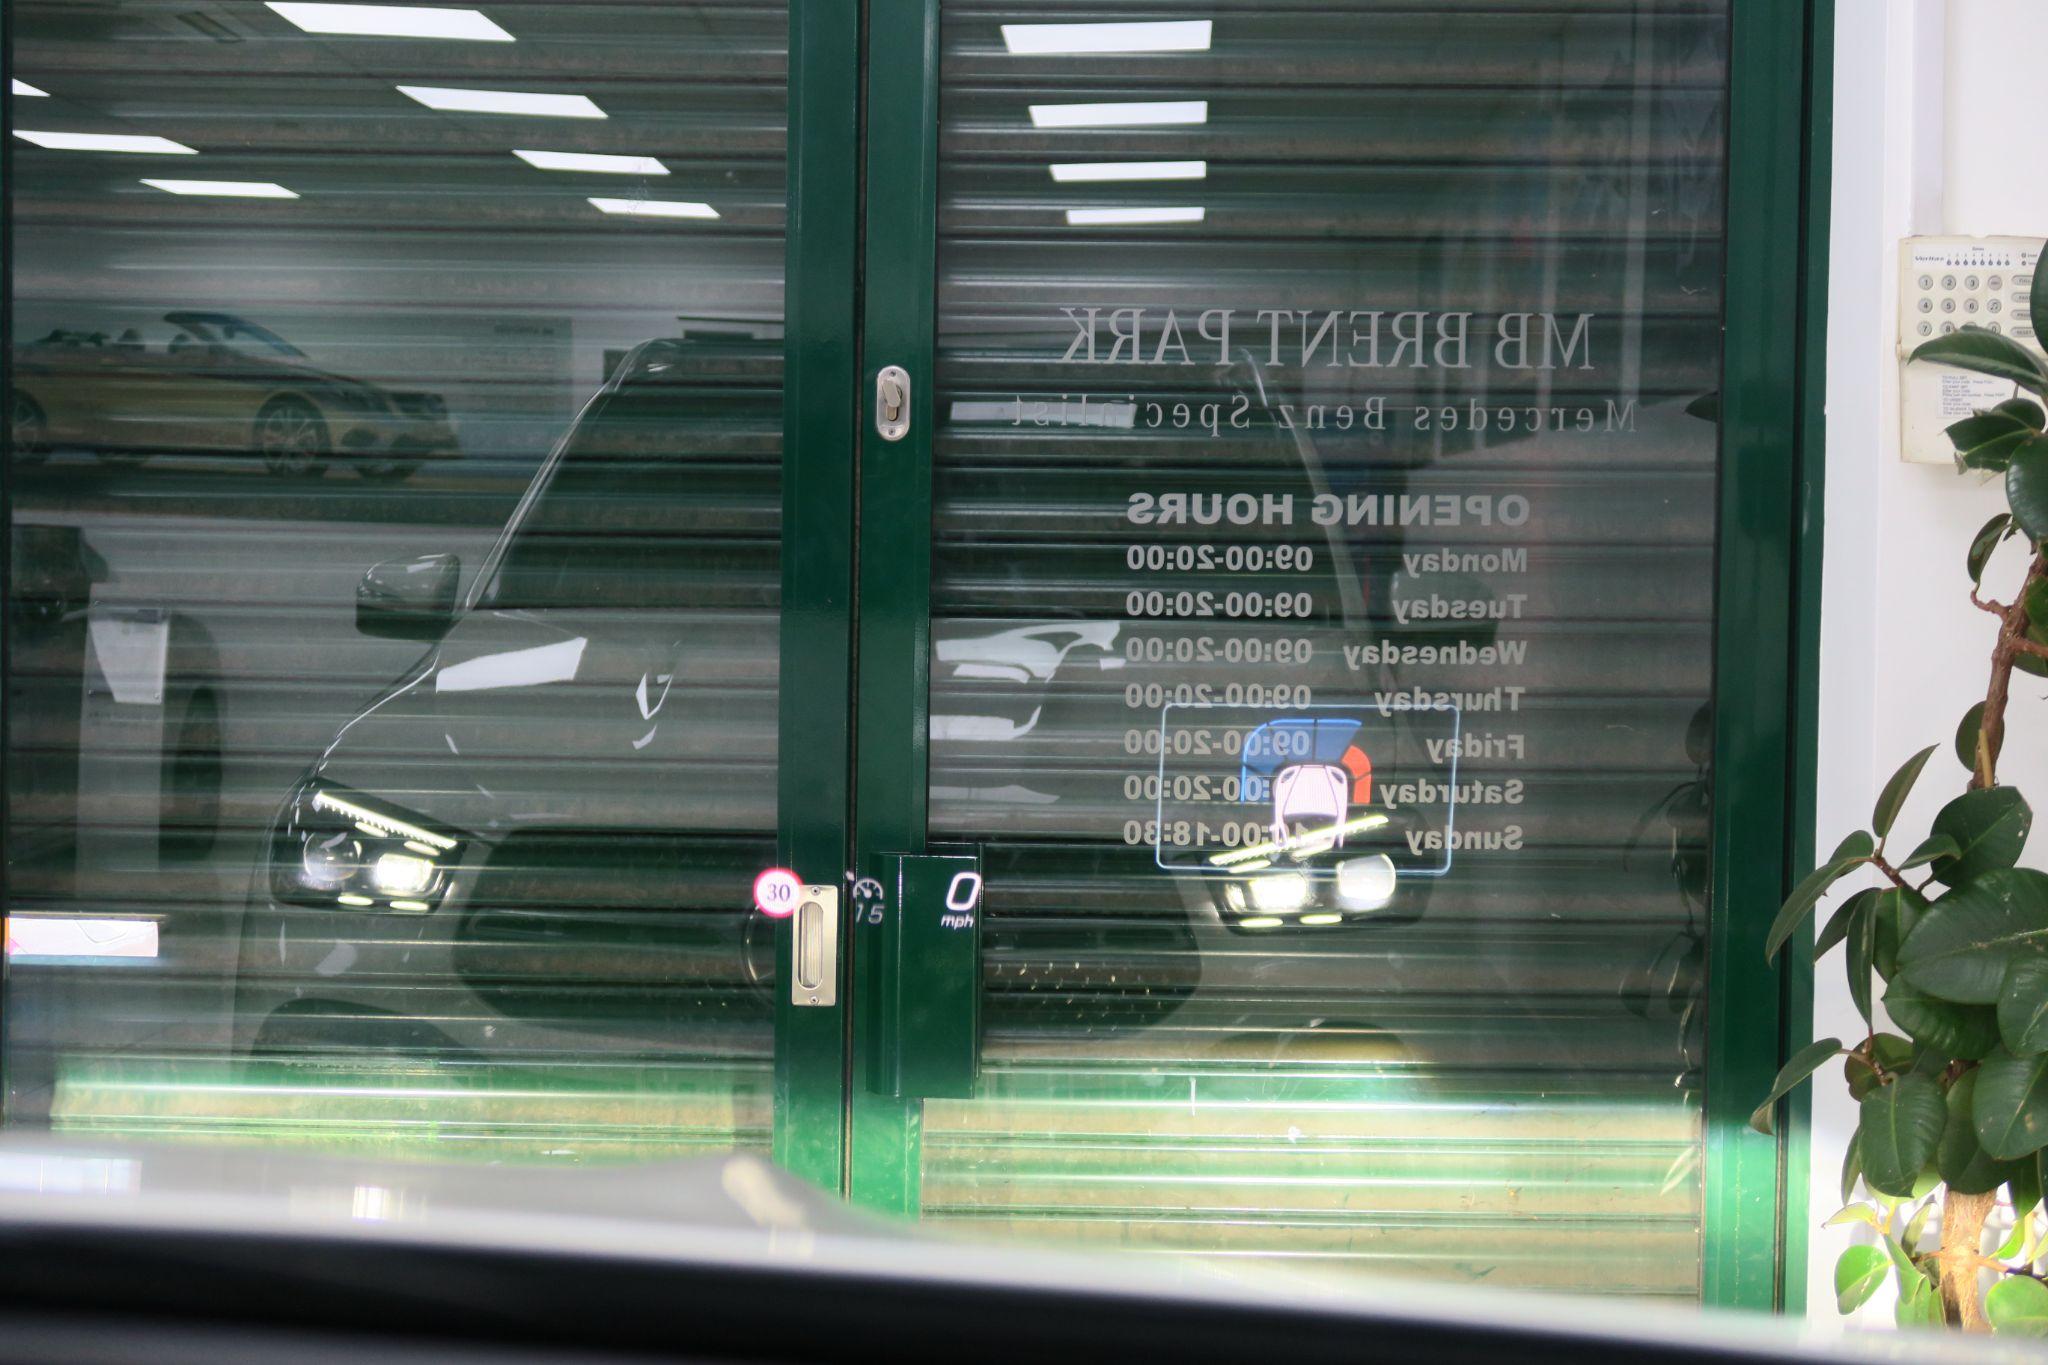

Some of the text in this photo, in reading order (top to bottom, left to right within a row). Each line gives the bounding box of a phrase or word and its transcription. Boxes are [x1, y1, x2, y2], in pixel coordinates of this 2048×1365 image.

[766, 883, 791, 902] 30
[946, 871, 982, 911] 0
[940, 914, 974, 930] mph
